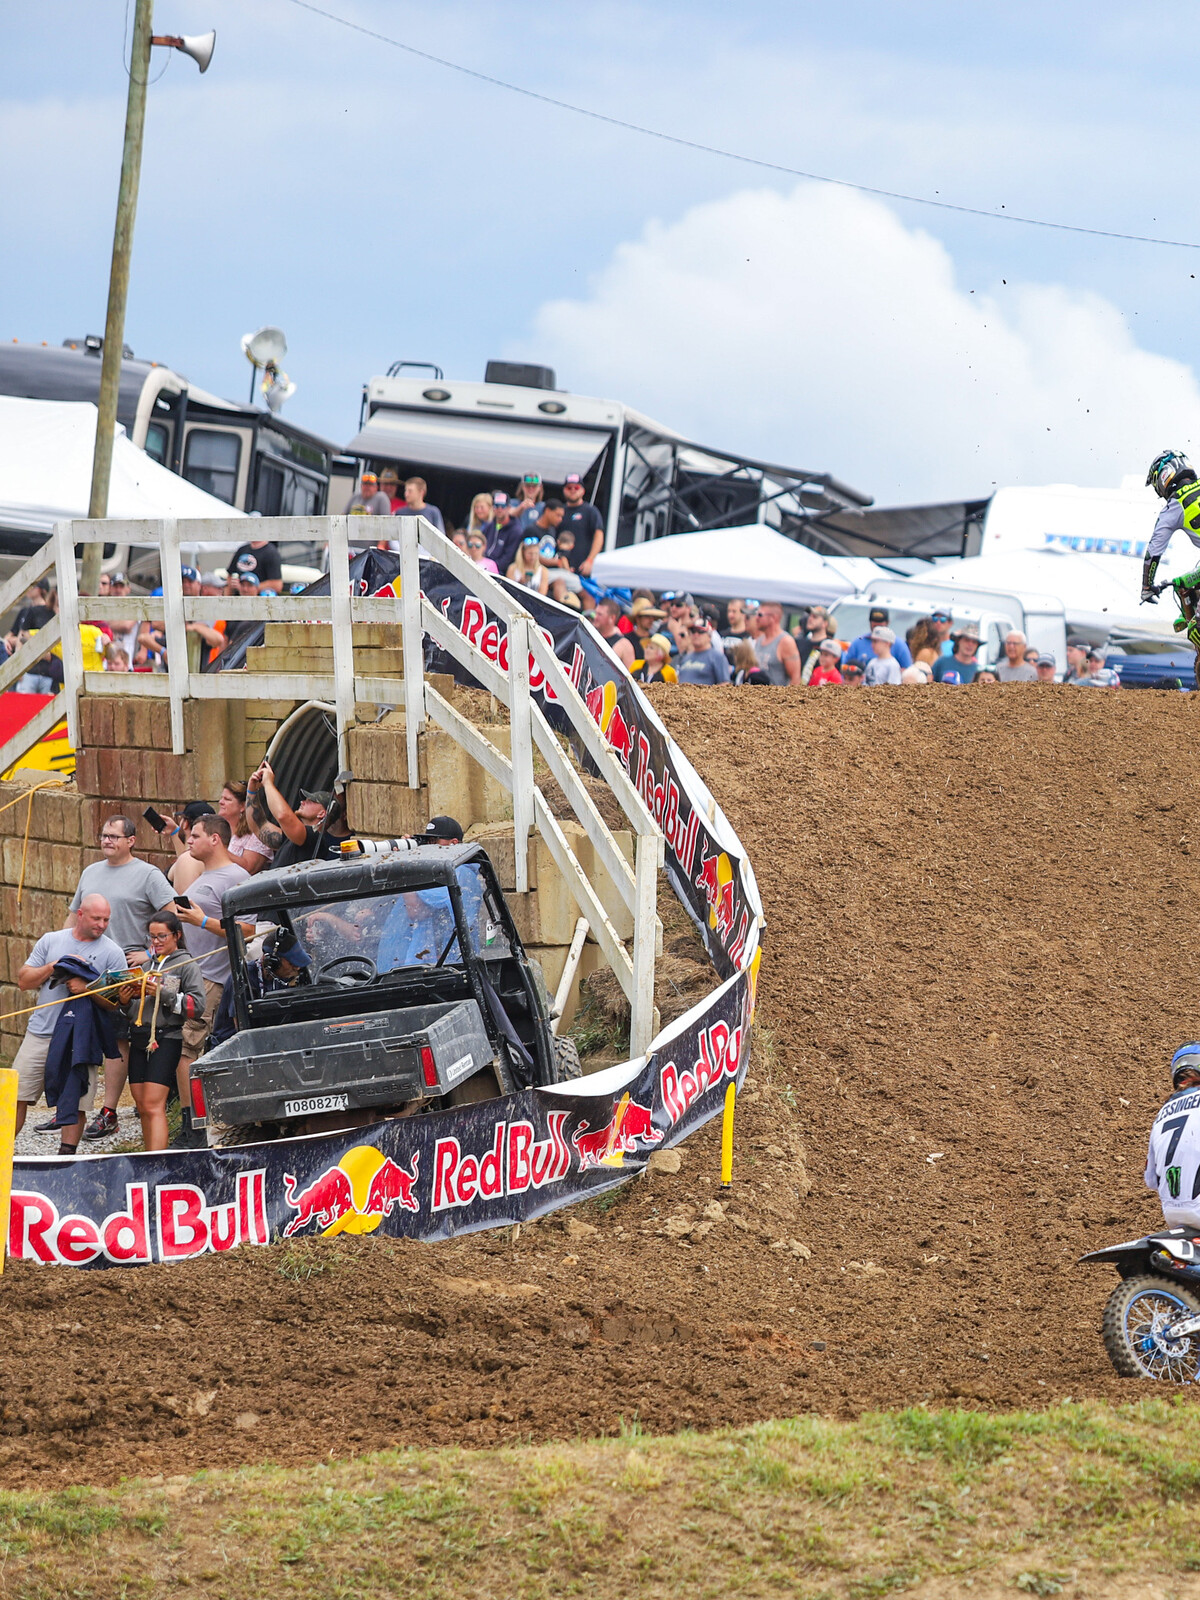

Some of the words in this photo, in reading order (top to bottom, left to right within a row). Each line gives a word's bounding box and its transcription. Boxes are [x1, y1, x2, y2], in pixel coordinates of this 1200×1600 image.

[431, 1121, 506, 1212] Red
[506, 1110, 572, 1195] Bull
[1161, 1114, 1190, 1167] 7
[8, 1181, 152, 1266] Red
[155, 1168, 270, 1262] Bull
